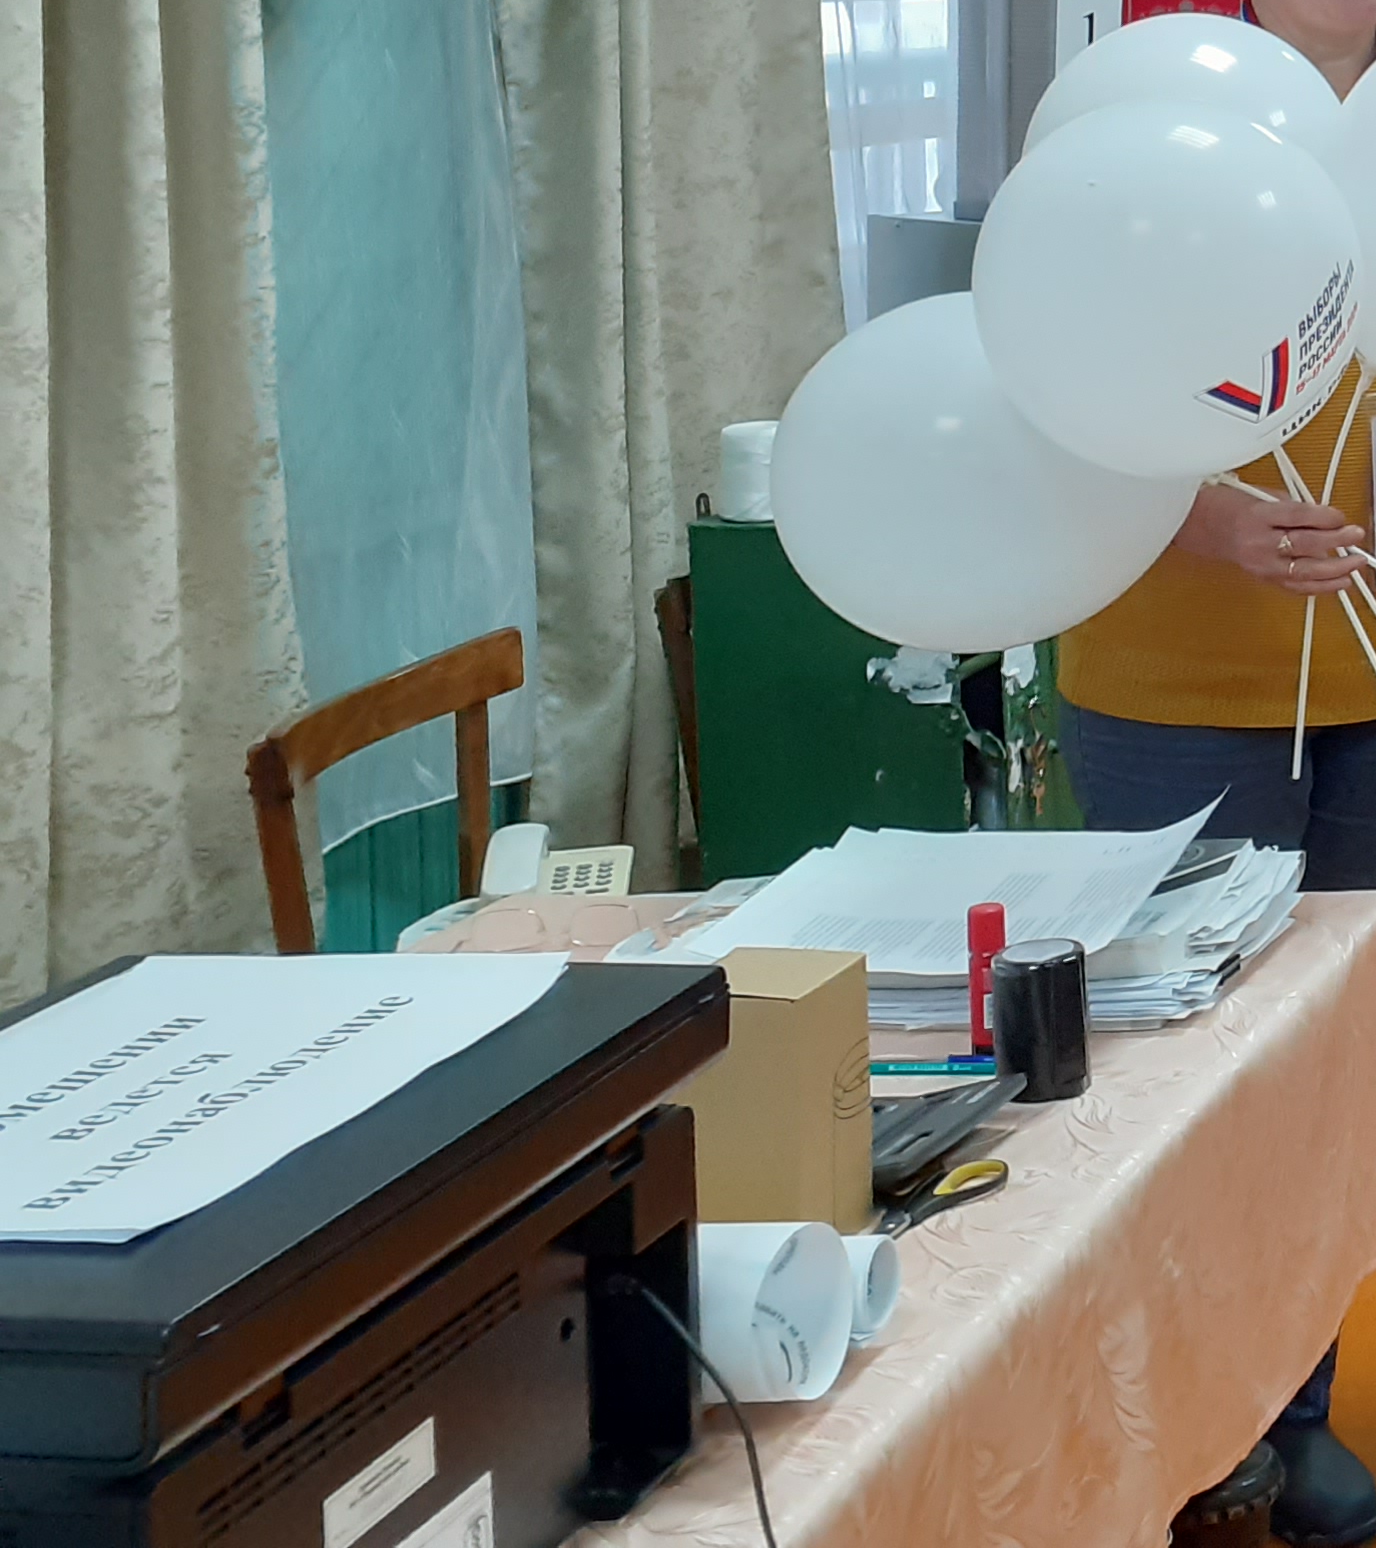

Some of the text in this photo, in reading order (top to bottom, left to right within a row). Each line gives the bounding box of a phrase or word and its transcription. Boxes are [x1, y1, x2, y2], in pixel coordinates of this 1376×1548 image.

[1298, 261, 1342, 340] ВЫБОРЫ
[1298, 315, 1342, 380] РОССИИ
[22, 994, 414, 1211] видеонаблюдение
[49, 1052, 233, 1141] ведется
